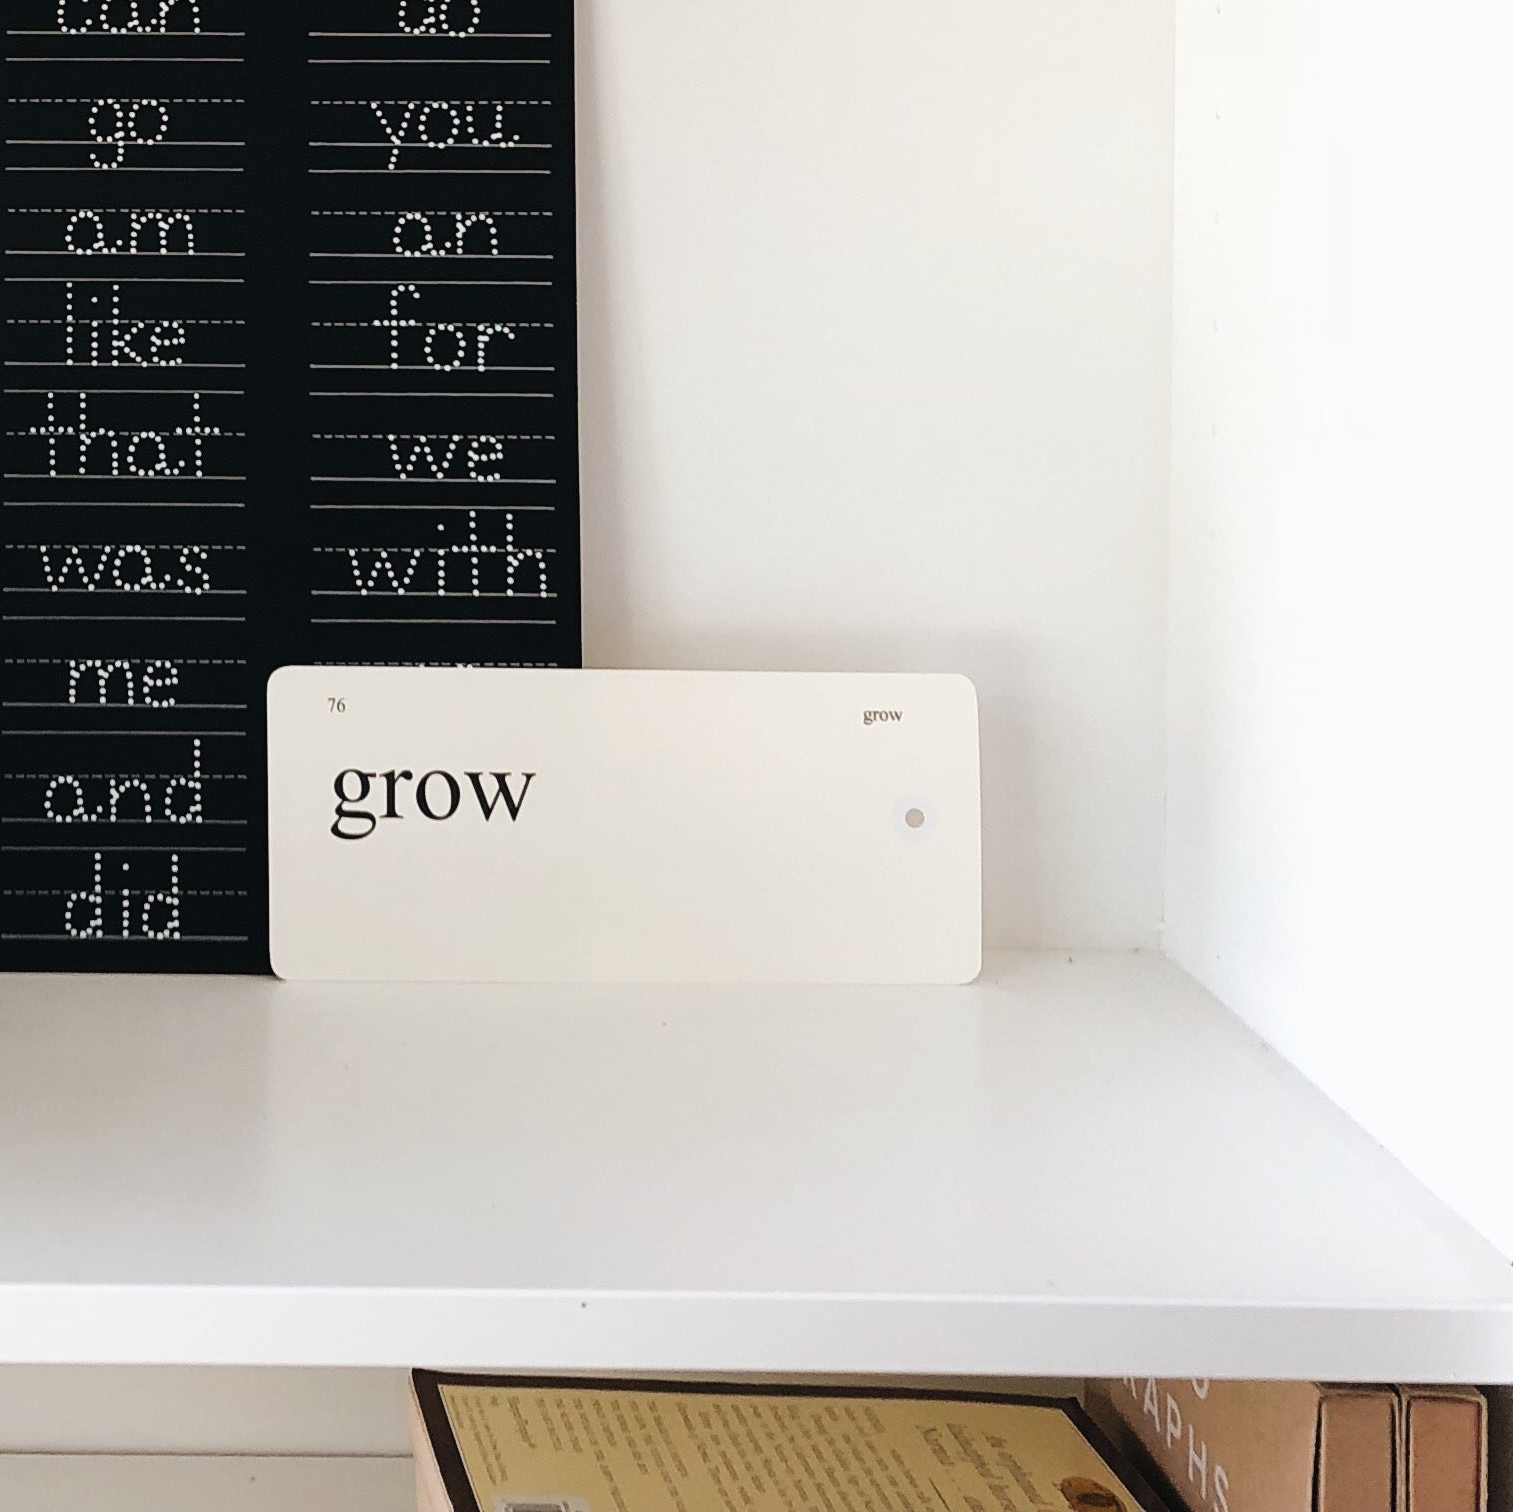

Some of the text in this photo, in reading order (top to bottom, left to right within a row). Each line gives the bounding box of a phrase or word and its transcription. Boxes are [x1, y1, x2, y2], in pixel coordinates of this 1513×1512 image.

[88, 98, 169, 170] go
[371, 102, 519, 170] you
[65, 211, 194, 256] am
[393, 212, 498, 258] an
[66, 282, 186, 368] like
[373, 284, 515, 372] for
[30, 392, 220, 477] that
[387, 434, 503, 482] we
[40, 545, 210, 595] was
[349, 510, 547, 598] with
[69, 660, 178, 708] me
[327, 696, 347, 714] 76
[862, 708, 903, 726] grow
[44, 739, 203, 824] and
[329, 767, 537, 841] grow
[65, 853, 180, 939] did
